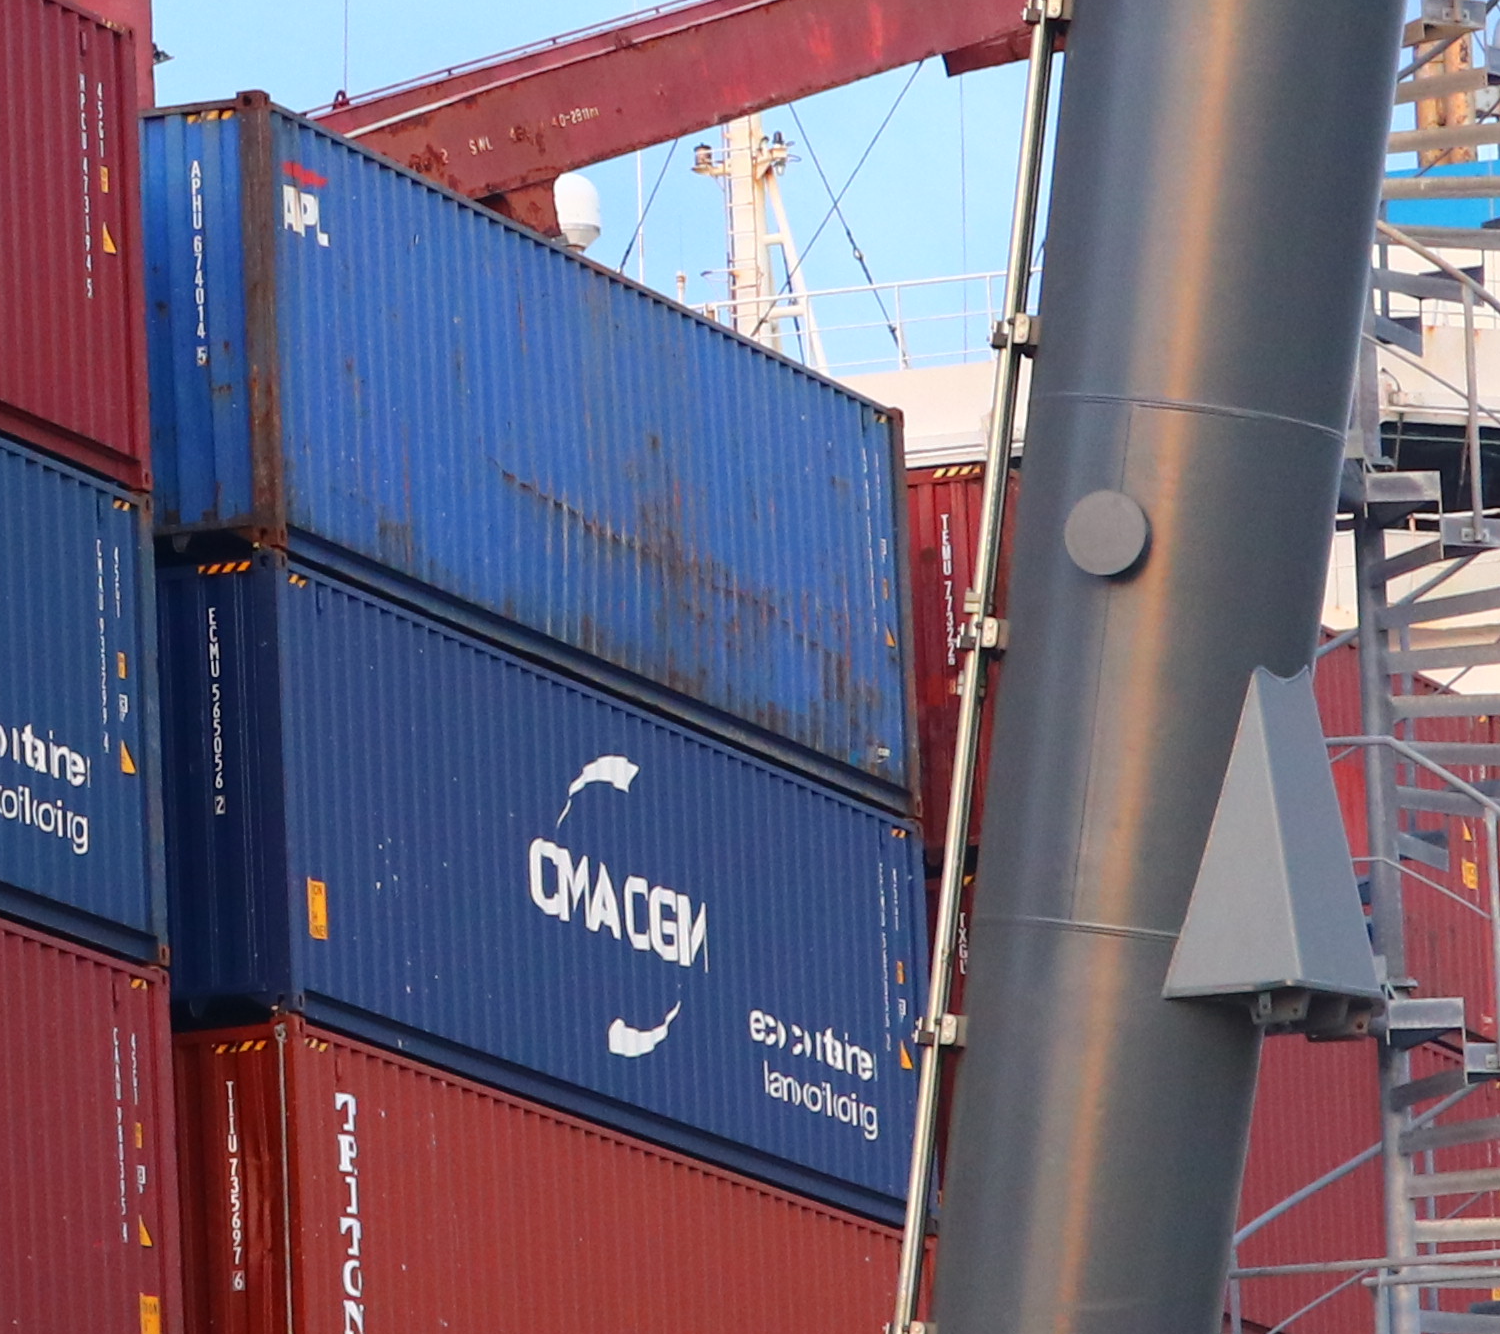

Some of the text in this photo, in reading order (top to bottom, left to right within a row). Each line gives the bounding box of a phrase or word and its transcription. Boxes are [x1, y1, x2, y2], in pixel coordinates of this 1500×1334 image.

[190, 160, 203, 231] APHU
[281, 183, 330, 247] APL
[192, 235, 207, 339] 674014
[940, 513, 953, 576] TEMU
[207, 607, 220, 678] ECMU
[210, 685, 225, 791] 565056
[529, 837, 709, 974] CMA CGM
[225, 1080, 238, 1153] TIIU
[227, 1158, 242, 1266] 735697
